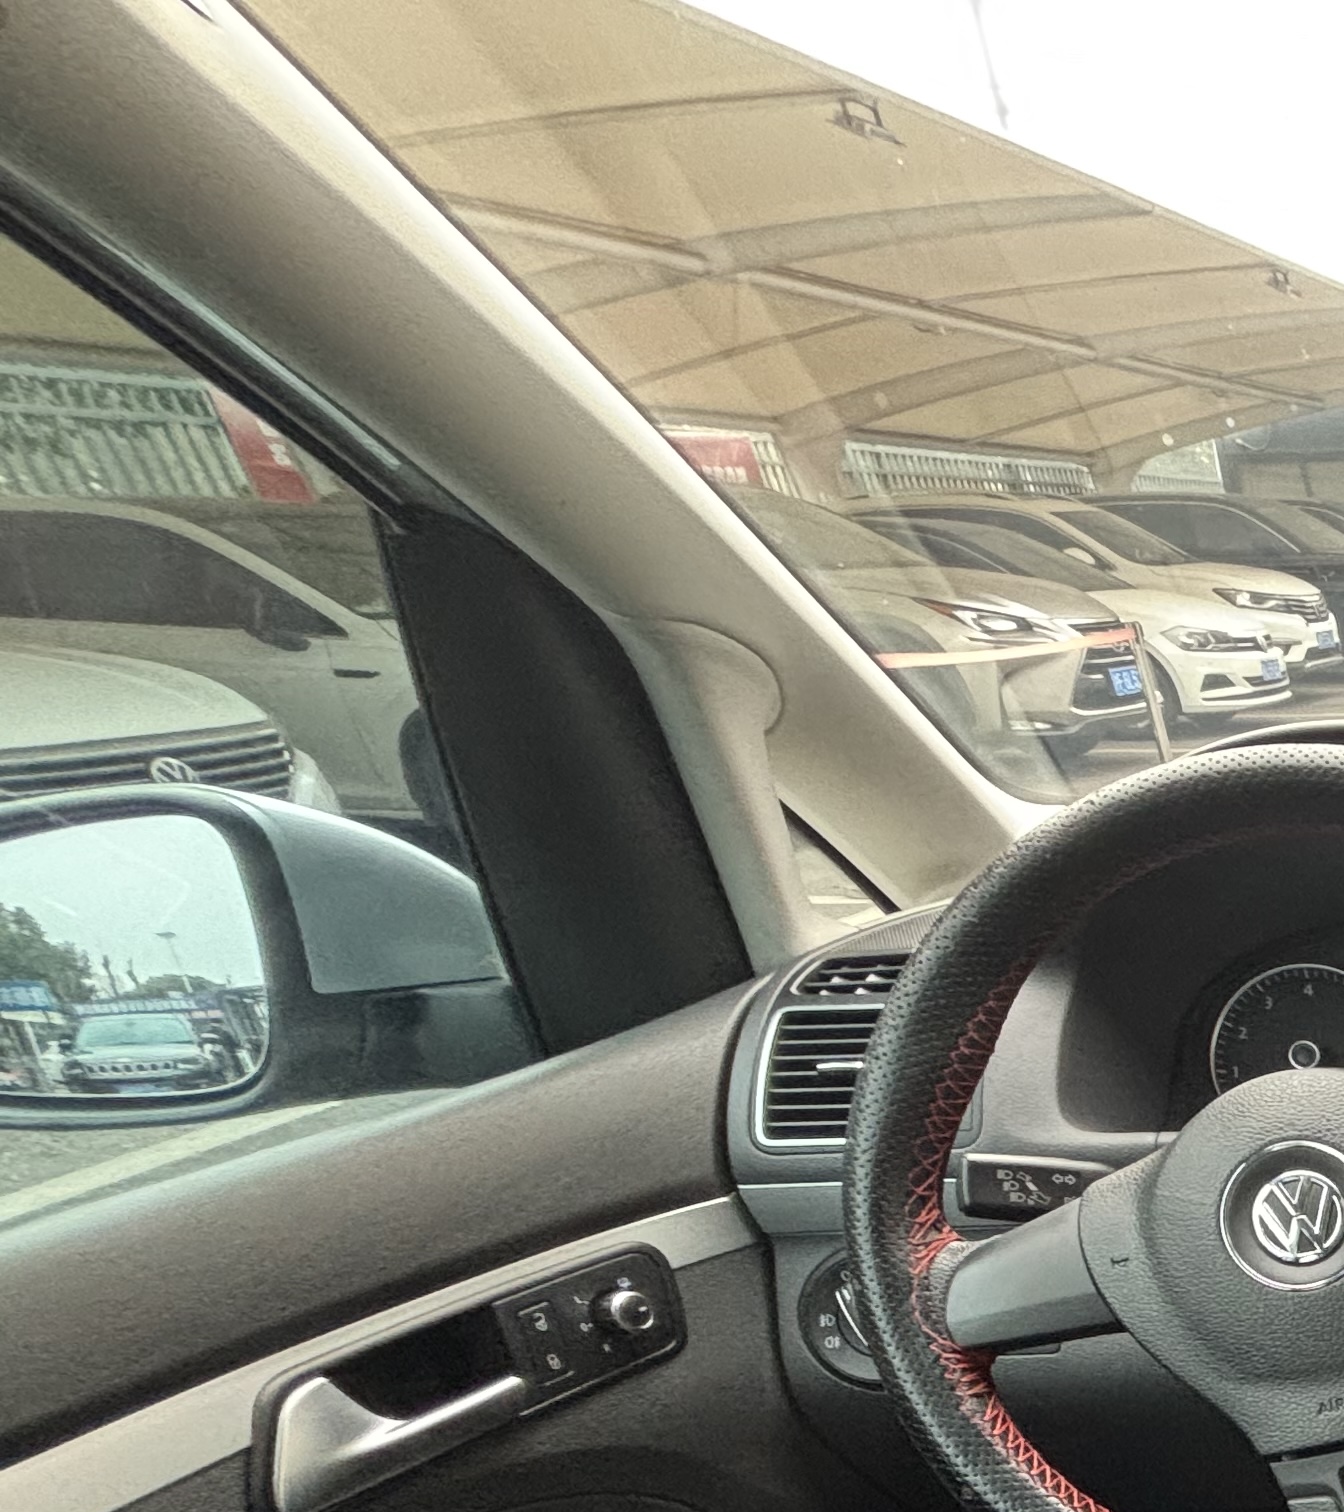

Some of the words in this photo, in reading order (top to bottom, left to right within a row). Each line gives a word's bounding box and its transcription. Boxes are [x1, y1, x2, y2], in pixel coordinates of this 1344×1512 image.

[1303, 984, 1314, 996] 4
[1265, 997, 1273, 1009] 3
[1239, 1027, 1248, 1039] 2
